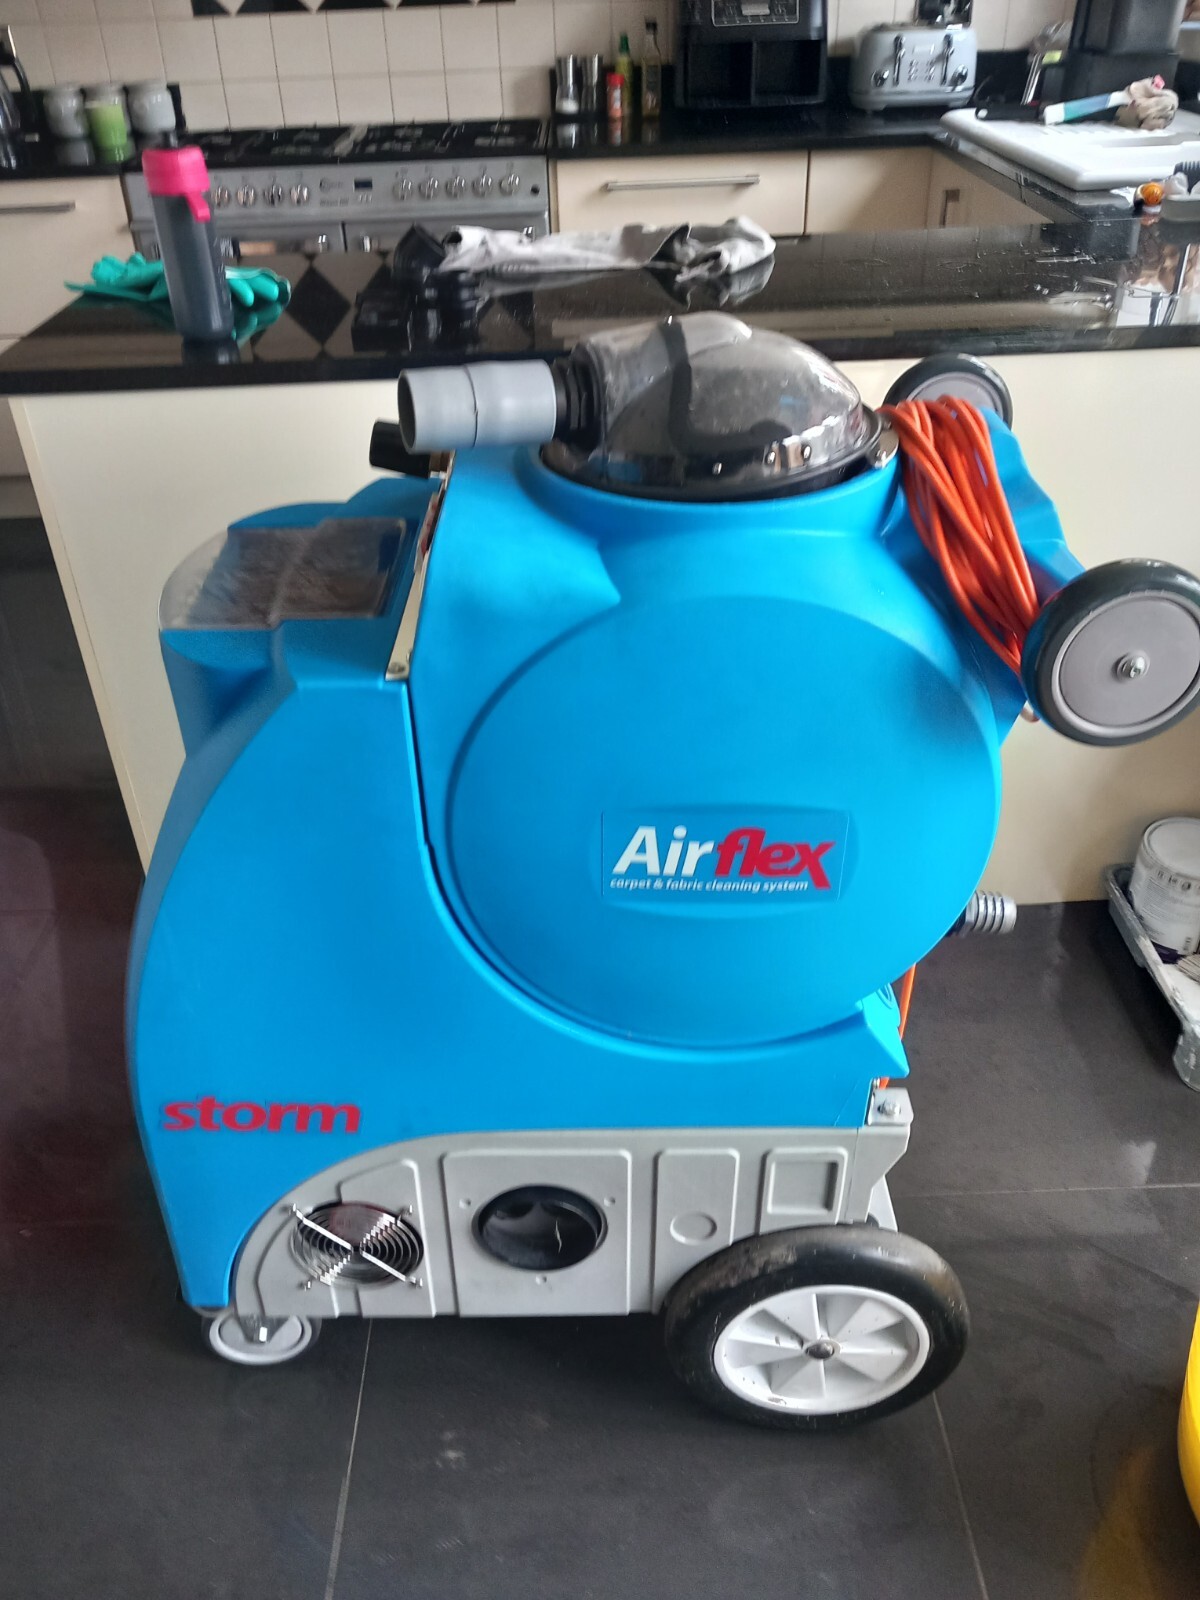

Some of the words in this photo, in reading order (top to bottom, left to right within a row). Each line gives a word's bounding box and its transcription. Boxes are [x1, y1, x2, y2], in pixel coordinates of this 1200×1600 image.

[612, 825, 836, 890] Airflex
[609, 878, 652, 891] carpet
[653, 878, 663, 890] &
[666, 878, 703, 892] fabric
[705, 879, 761, 894] cleaning
[762, 880, 808, 893] system
[163, 1095, 361, 1134] storm
